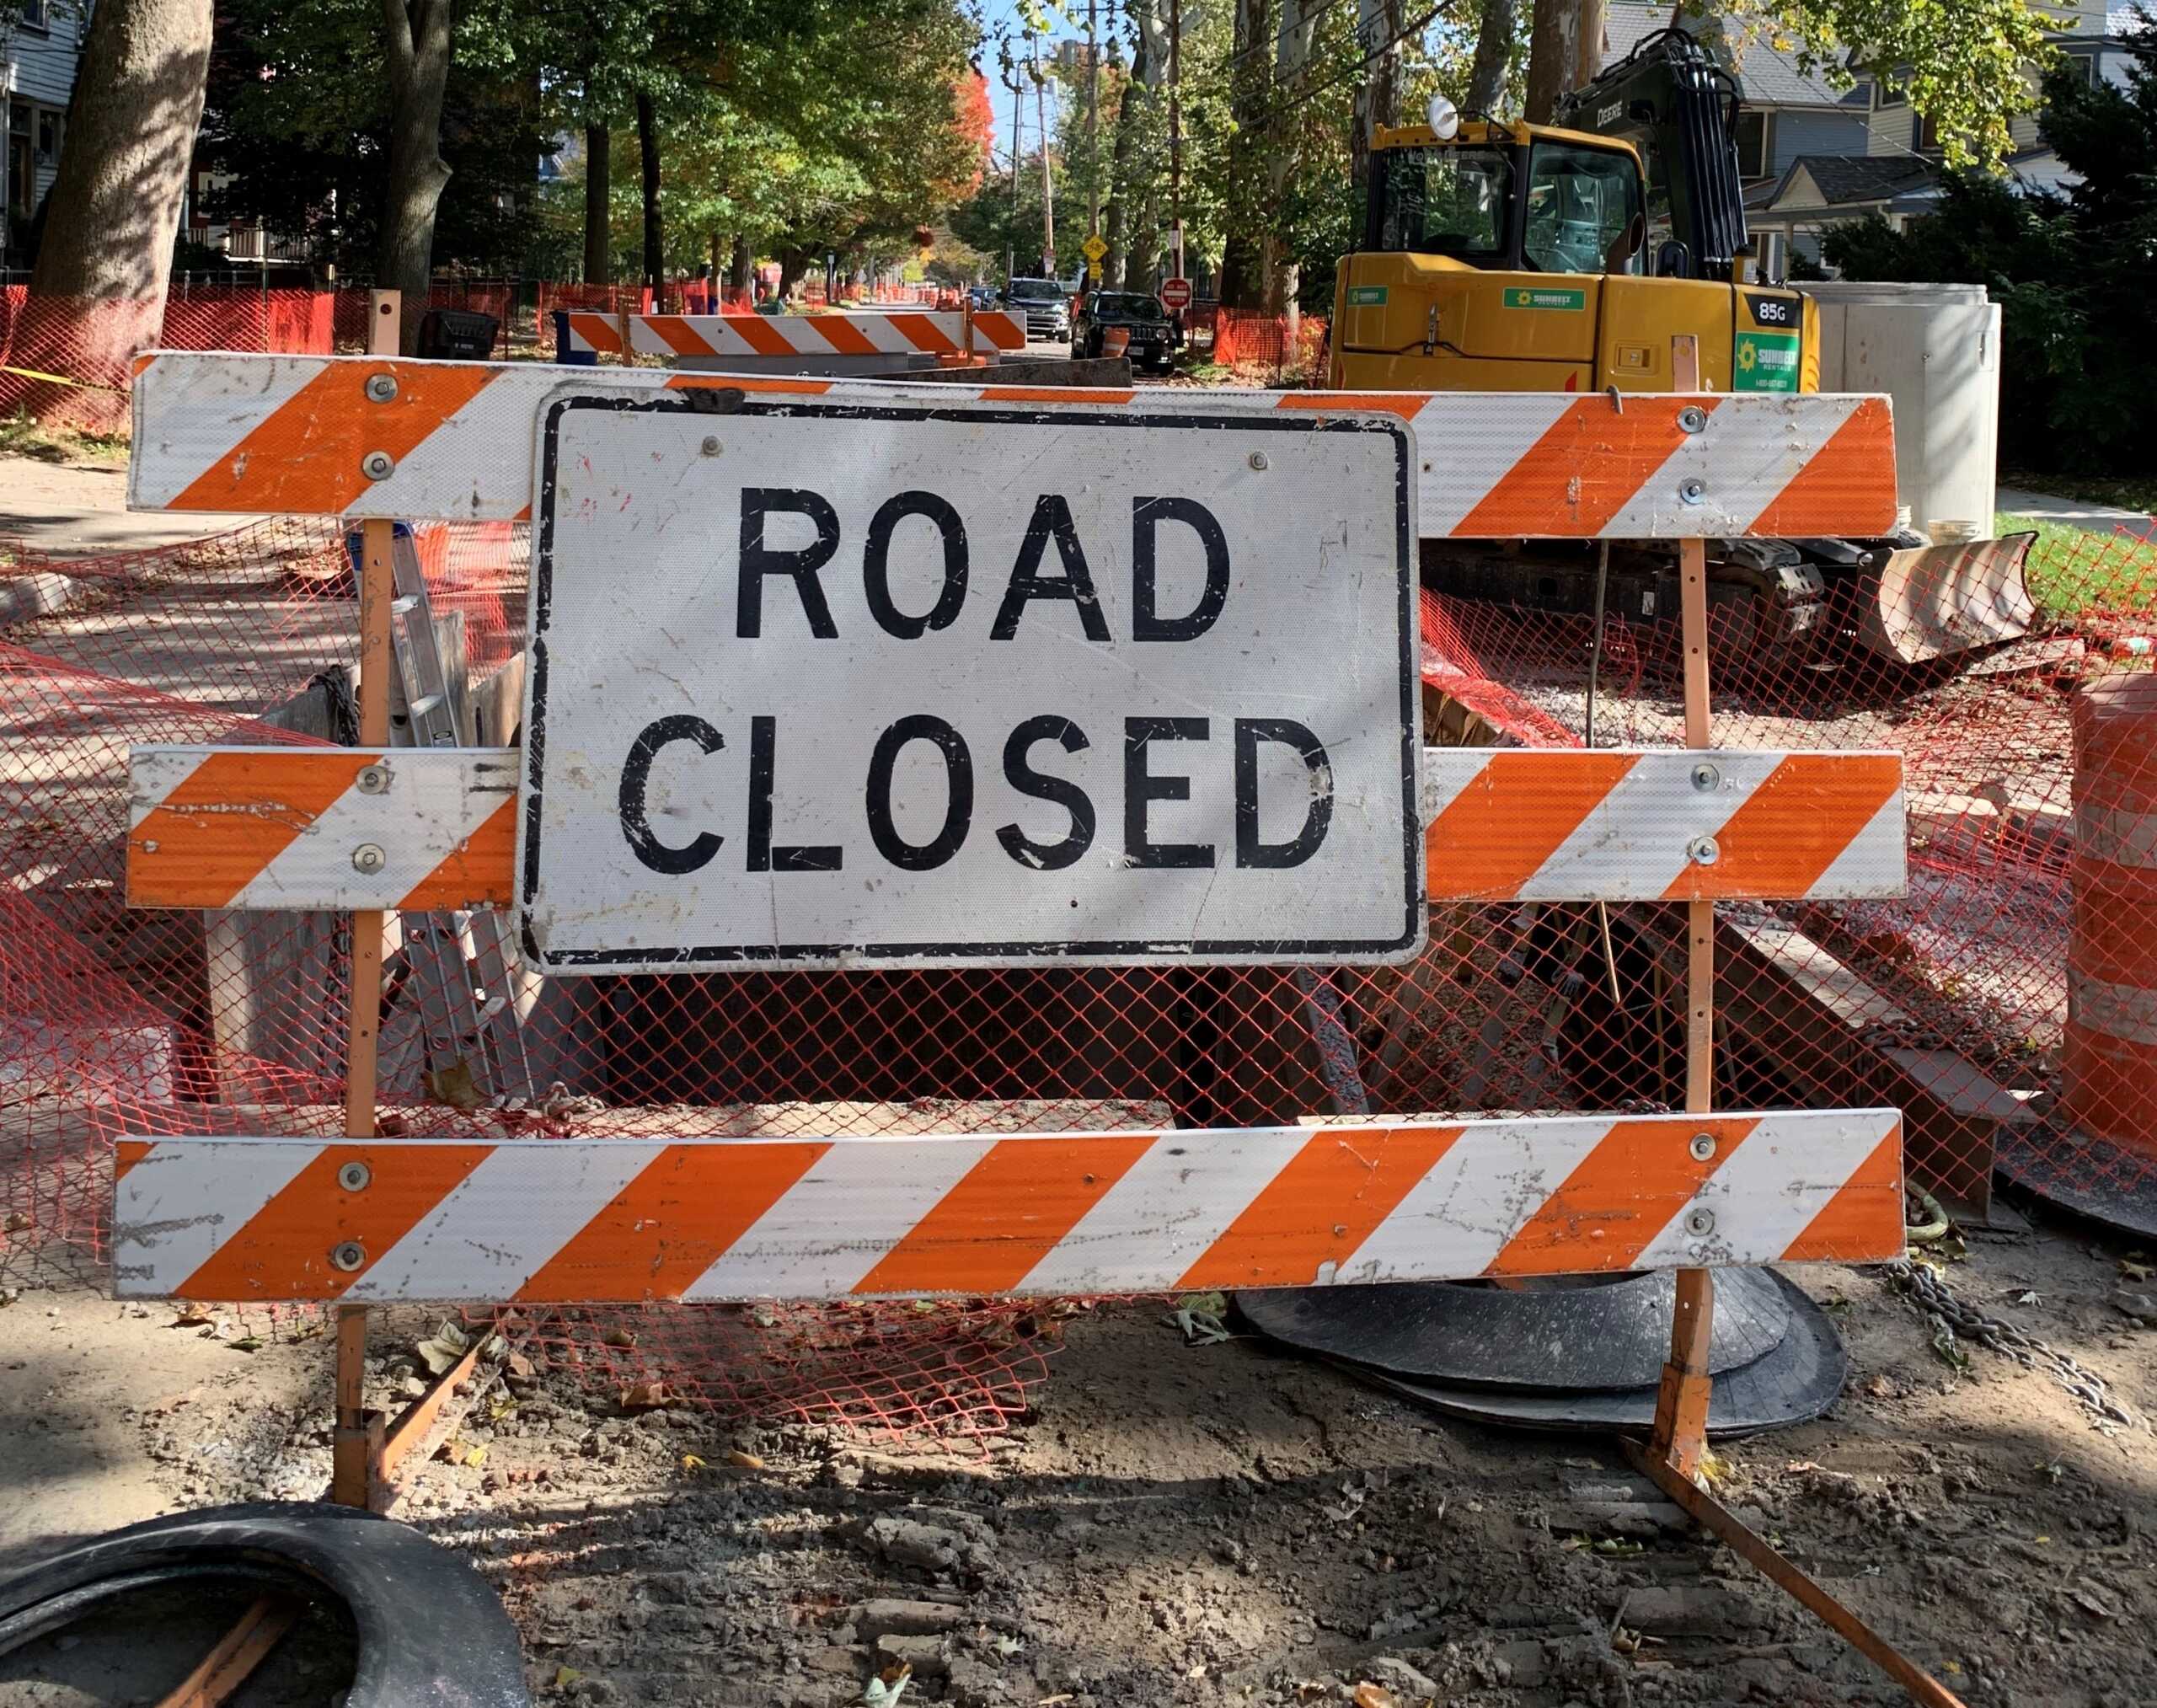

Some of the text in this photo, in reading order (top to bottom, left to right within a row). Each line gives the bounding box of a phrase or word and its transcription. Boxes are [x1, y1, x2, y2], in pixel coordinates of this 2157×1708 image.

[1597, 100, 1622, 127] DEERE
[1759, 303, 1785, 320] 85G
[1758, 349, 1797, 365] SUNBELT
[736, 487, 1231, 643] ROAD
[618, 714, 1334, 875] CLOSED
